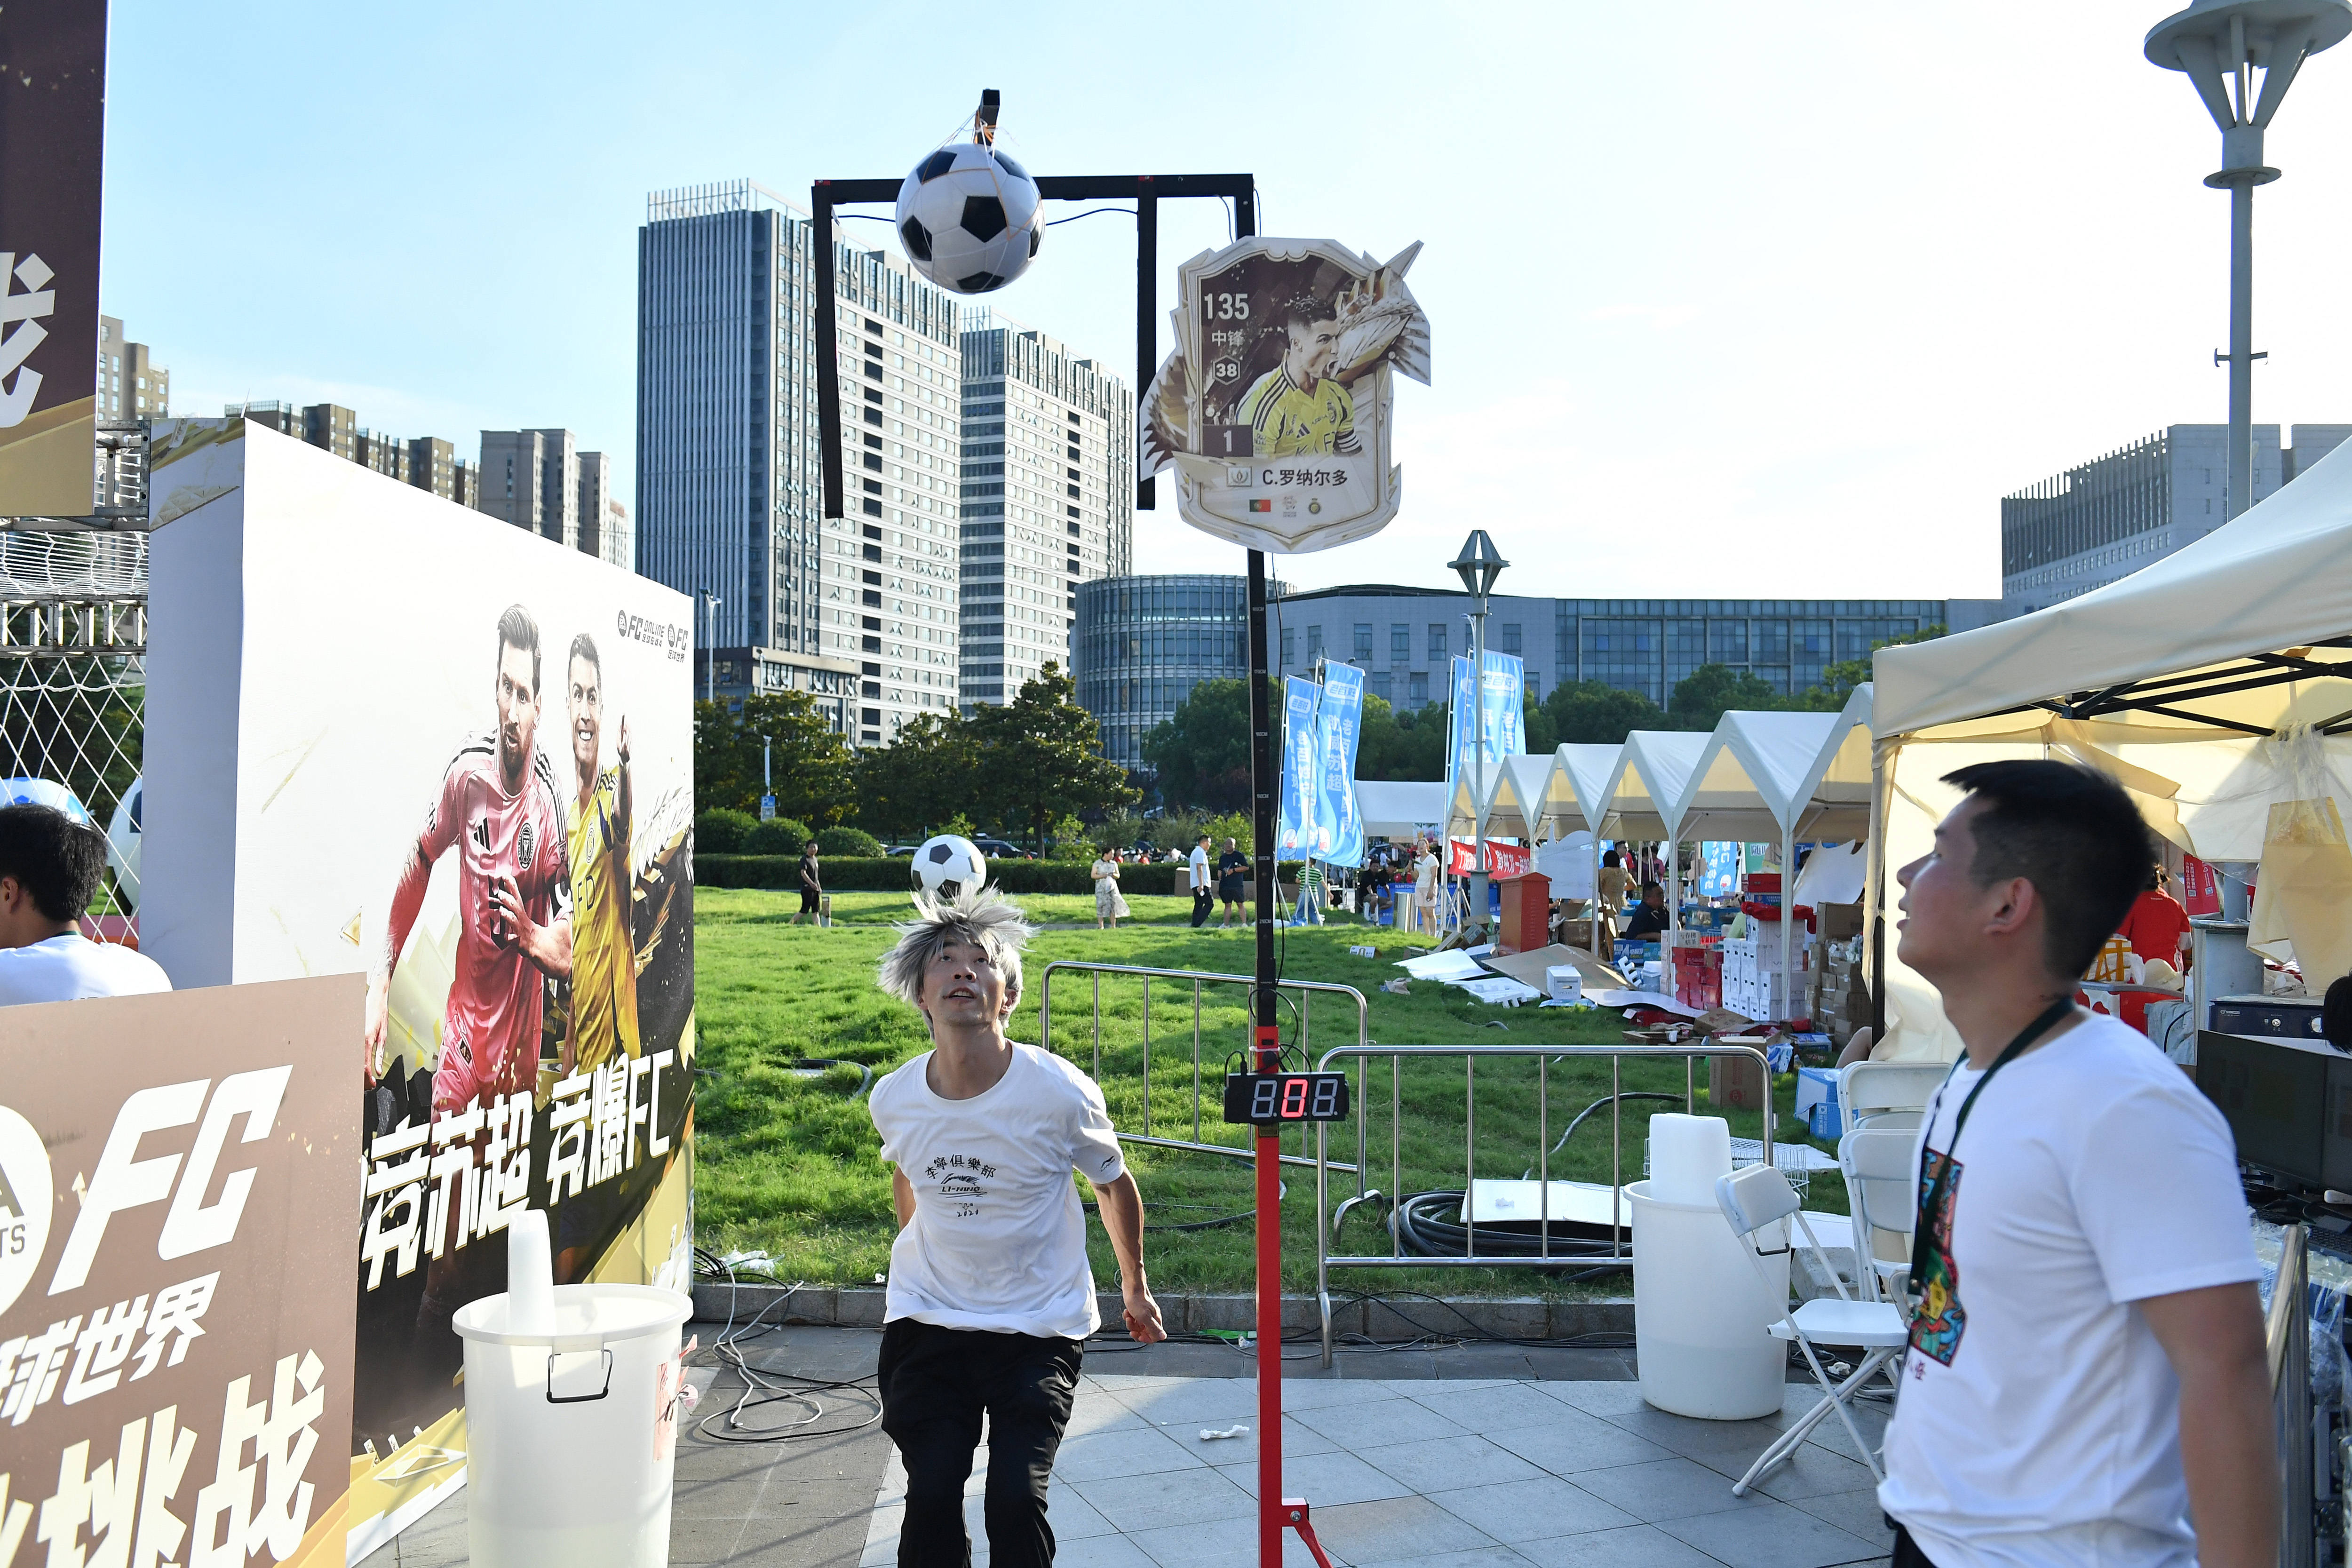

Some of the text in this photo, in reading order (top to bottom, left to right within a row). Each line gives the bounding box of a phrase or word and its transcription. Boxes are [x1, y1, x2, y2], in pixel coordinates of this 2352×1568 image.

[1204, 293, 1250, 320] 135
[1211, 329, 1244, 348] 中锋
[1216, 364, 1237, 377] 38
[1223, 430, 1232, 452] 1
[1262, 469, 1348, 486] C.罗纳尔多
[627, 615, 644, 640] FC
[644, 620, 665, 638] ONLINE
[675, 628, 688, 651] FC
[546, 1049, 674, 1207] 竞爆FC
[925, 1154, 996, 1179] 李寧俱樂部
[48, 1064, 294, 1296] FC
[361, 1090, 533, 1292] 竞苏超
[0, 1348, 325, 1568] 挑战
